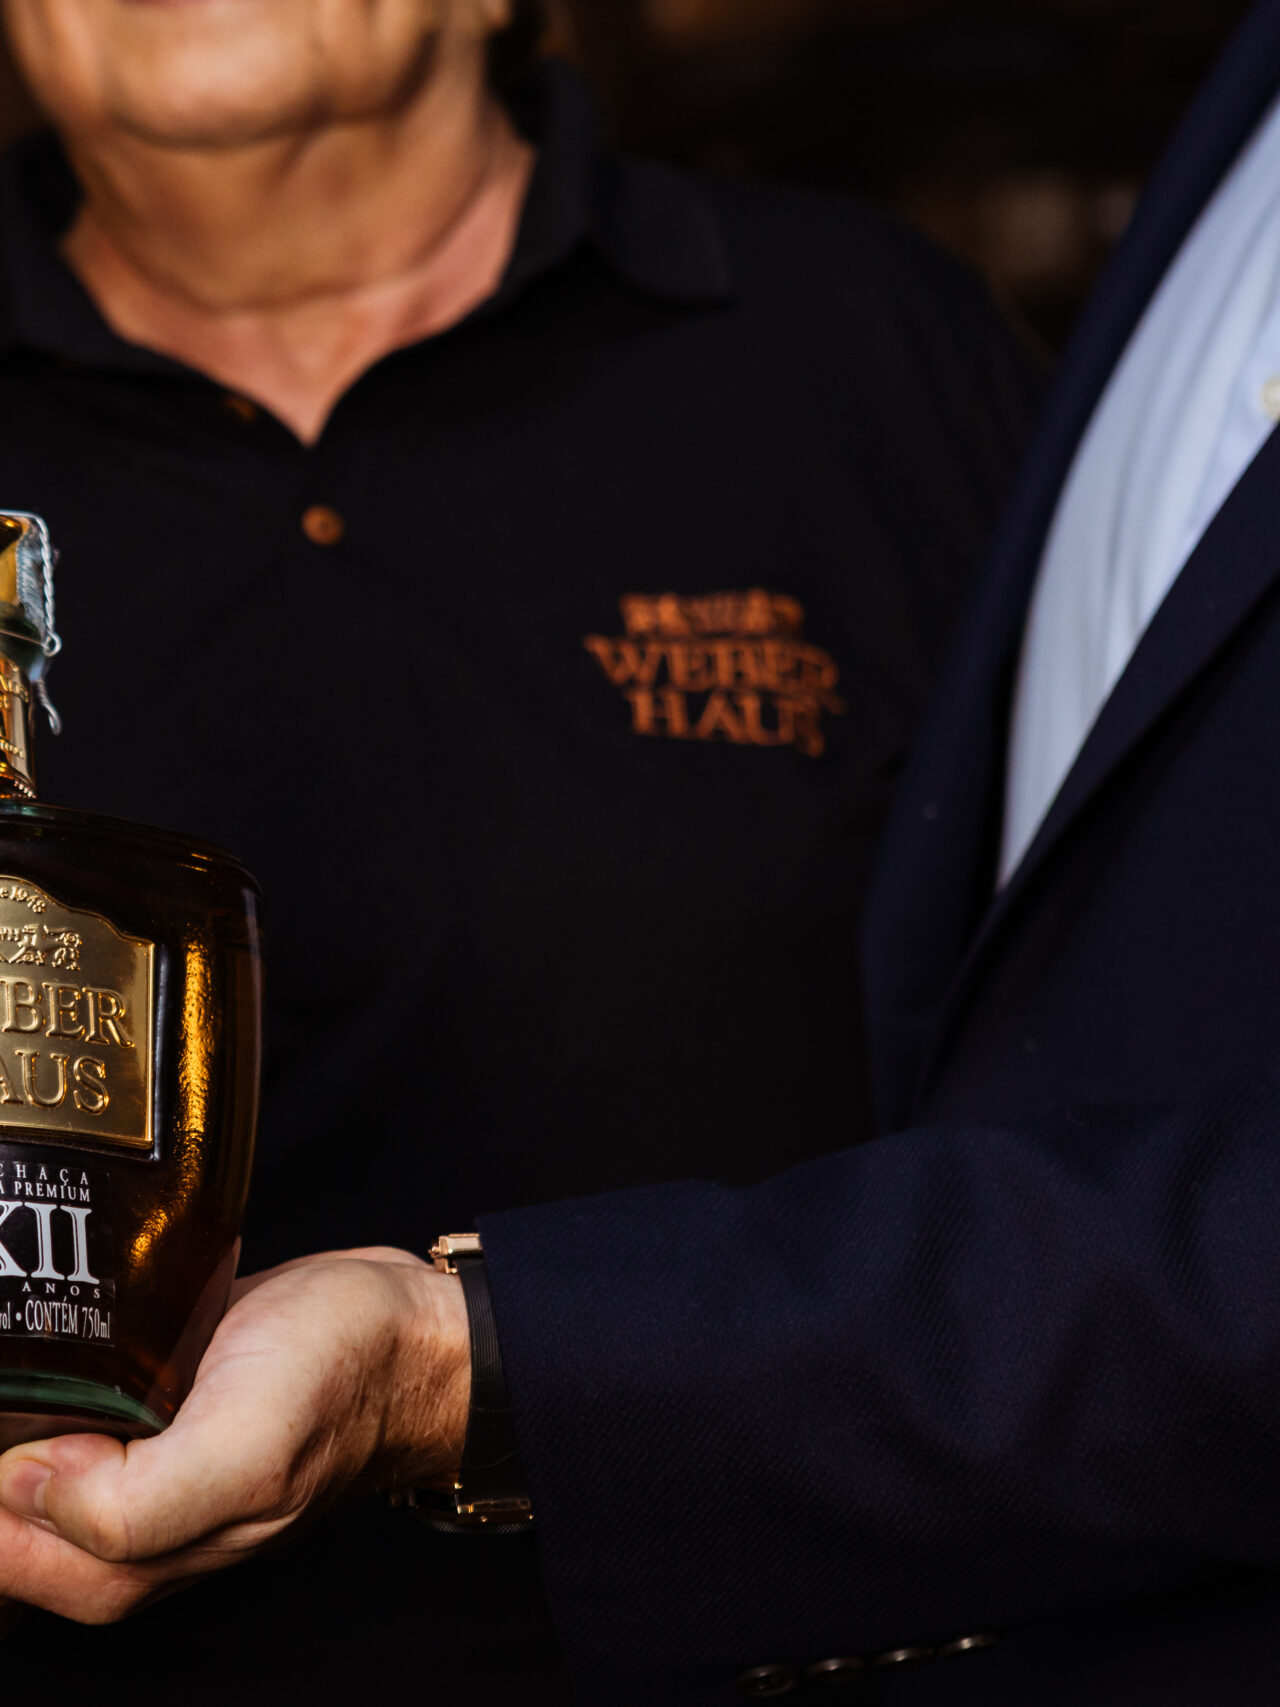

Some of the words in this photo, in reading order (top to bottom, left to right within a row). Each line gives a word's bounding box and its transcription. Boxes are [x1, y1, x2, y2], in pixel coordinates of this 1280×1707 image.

[14, 1181, 90, 1202] PREMIUM
[21, 1281, 101, 1299] ANOS
[25, 1296, 78, 1335] CONTÉM
[81, 1307, 111, 1339] 750ml
